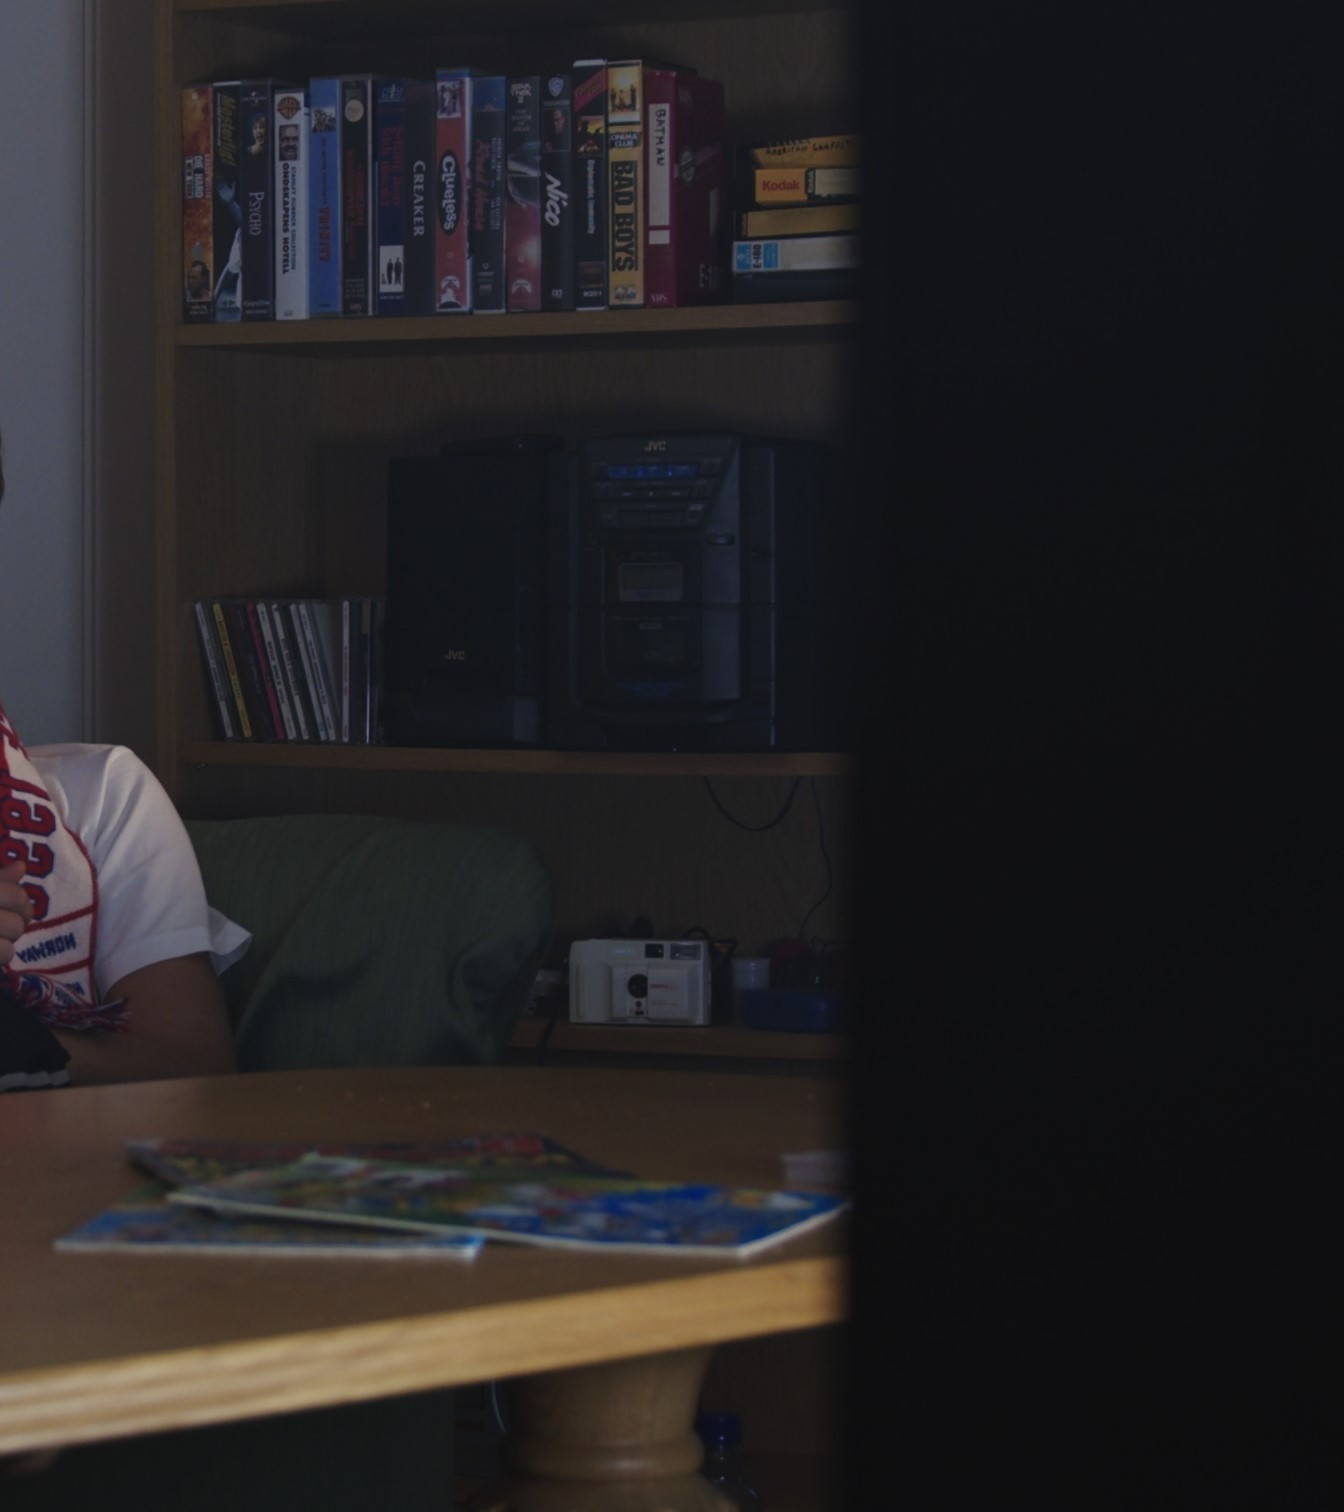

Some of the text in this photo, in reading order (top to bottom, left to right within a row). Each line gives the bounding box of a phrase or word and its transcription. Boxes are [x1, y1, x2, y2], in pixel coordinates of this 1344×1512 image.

[655, 108, 666, 166] BATMAN
[413, 160, 426, 236] CREAKER
[545, 172, 568, 227] Nico
[762, 180, 800, 191] Kodak
[249, 192, 265, 236] PSYCHO
[282, 163, 290, 274] ONDSKAPENS HOTELL
[614, 161, 634, 271] BAD BOYS
[644, 441, 666, 451] JVC
[444, 650, 465, 660] JVC
